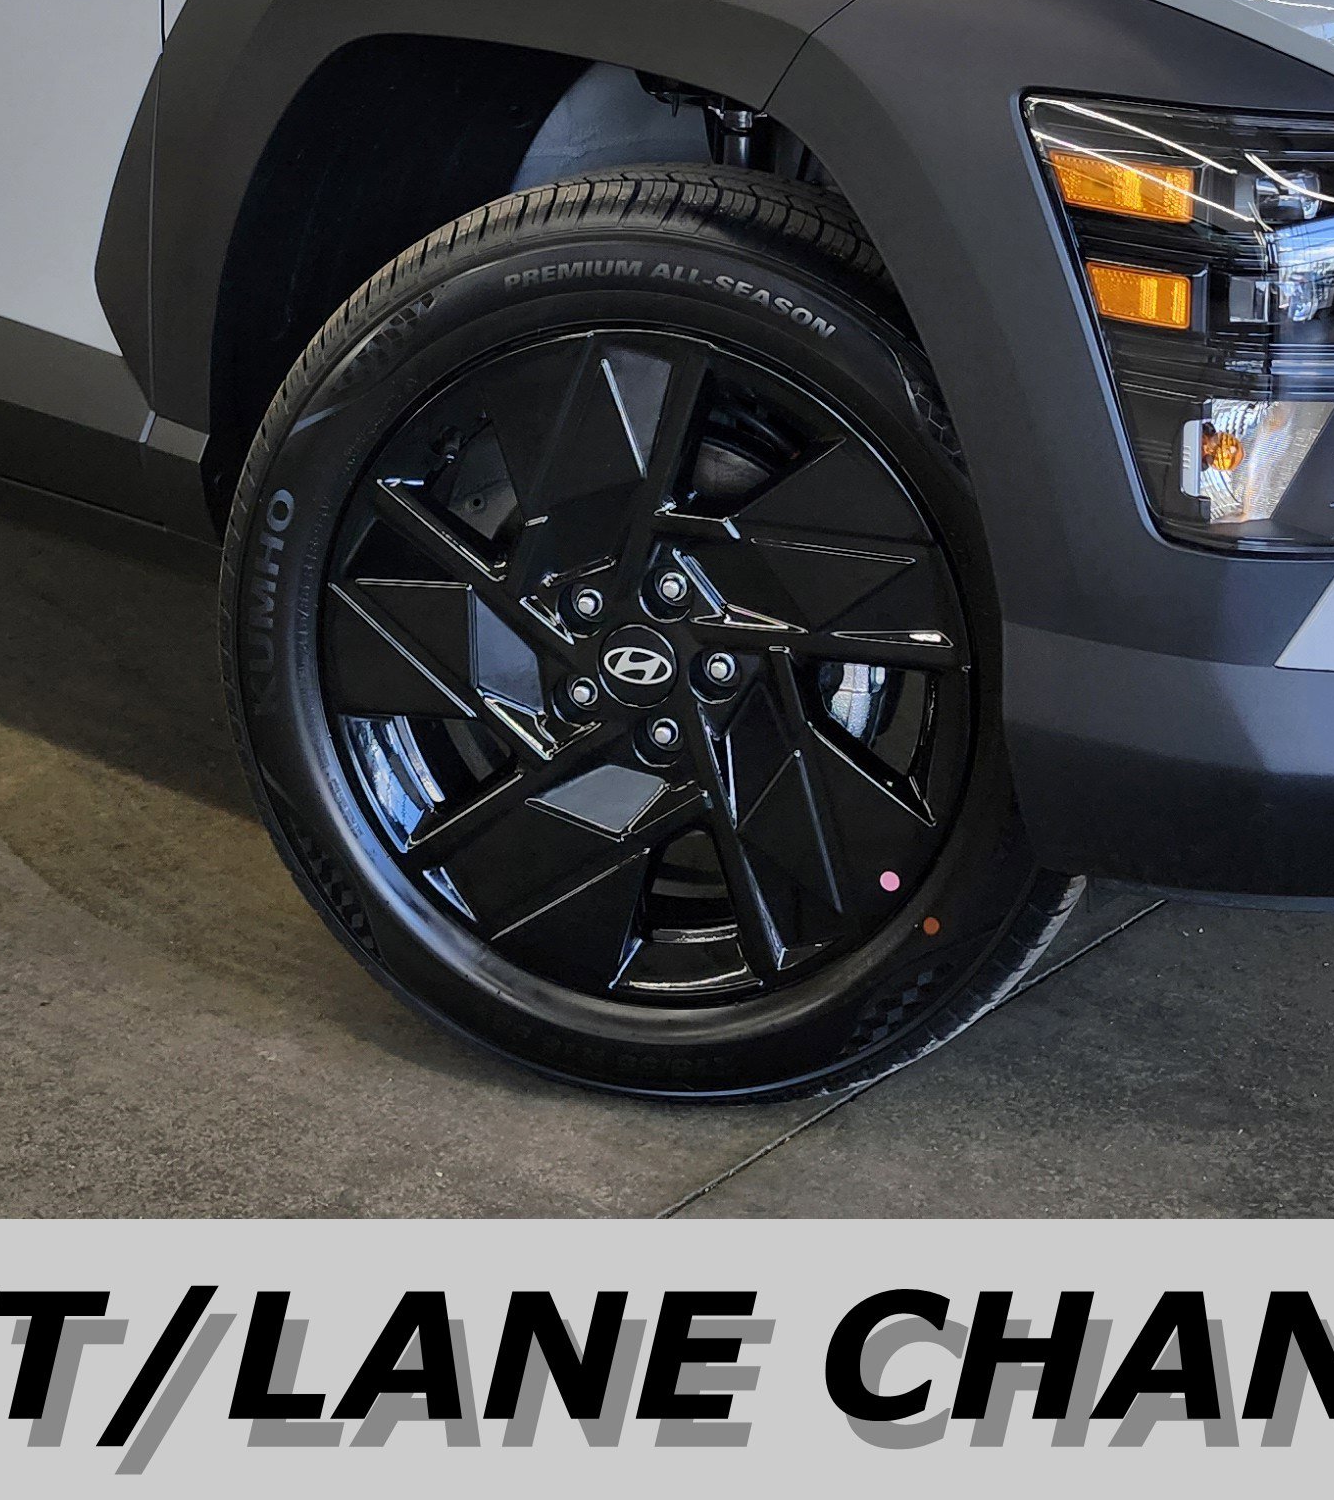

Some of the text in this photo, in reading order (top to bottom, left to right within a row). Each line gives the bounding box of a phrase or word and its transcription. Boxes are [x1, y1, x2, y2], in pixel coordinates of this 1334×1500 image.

[503, 259, 838, 340] PREMIUM ALL-SEASON
[249, 487, 296, 716] KUMHO
